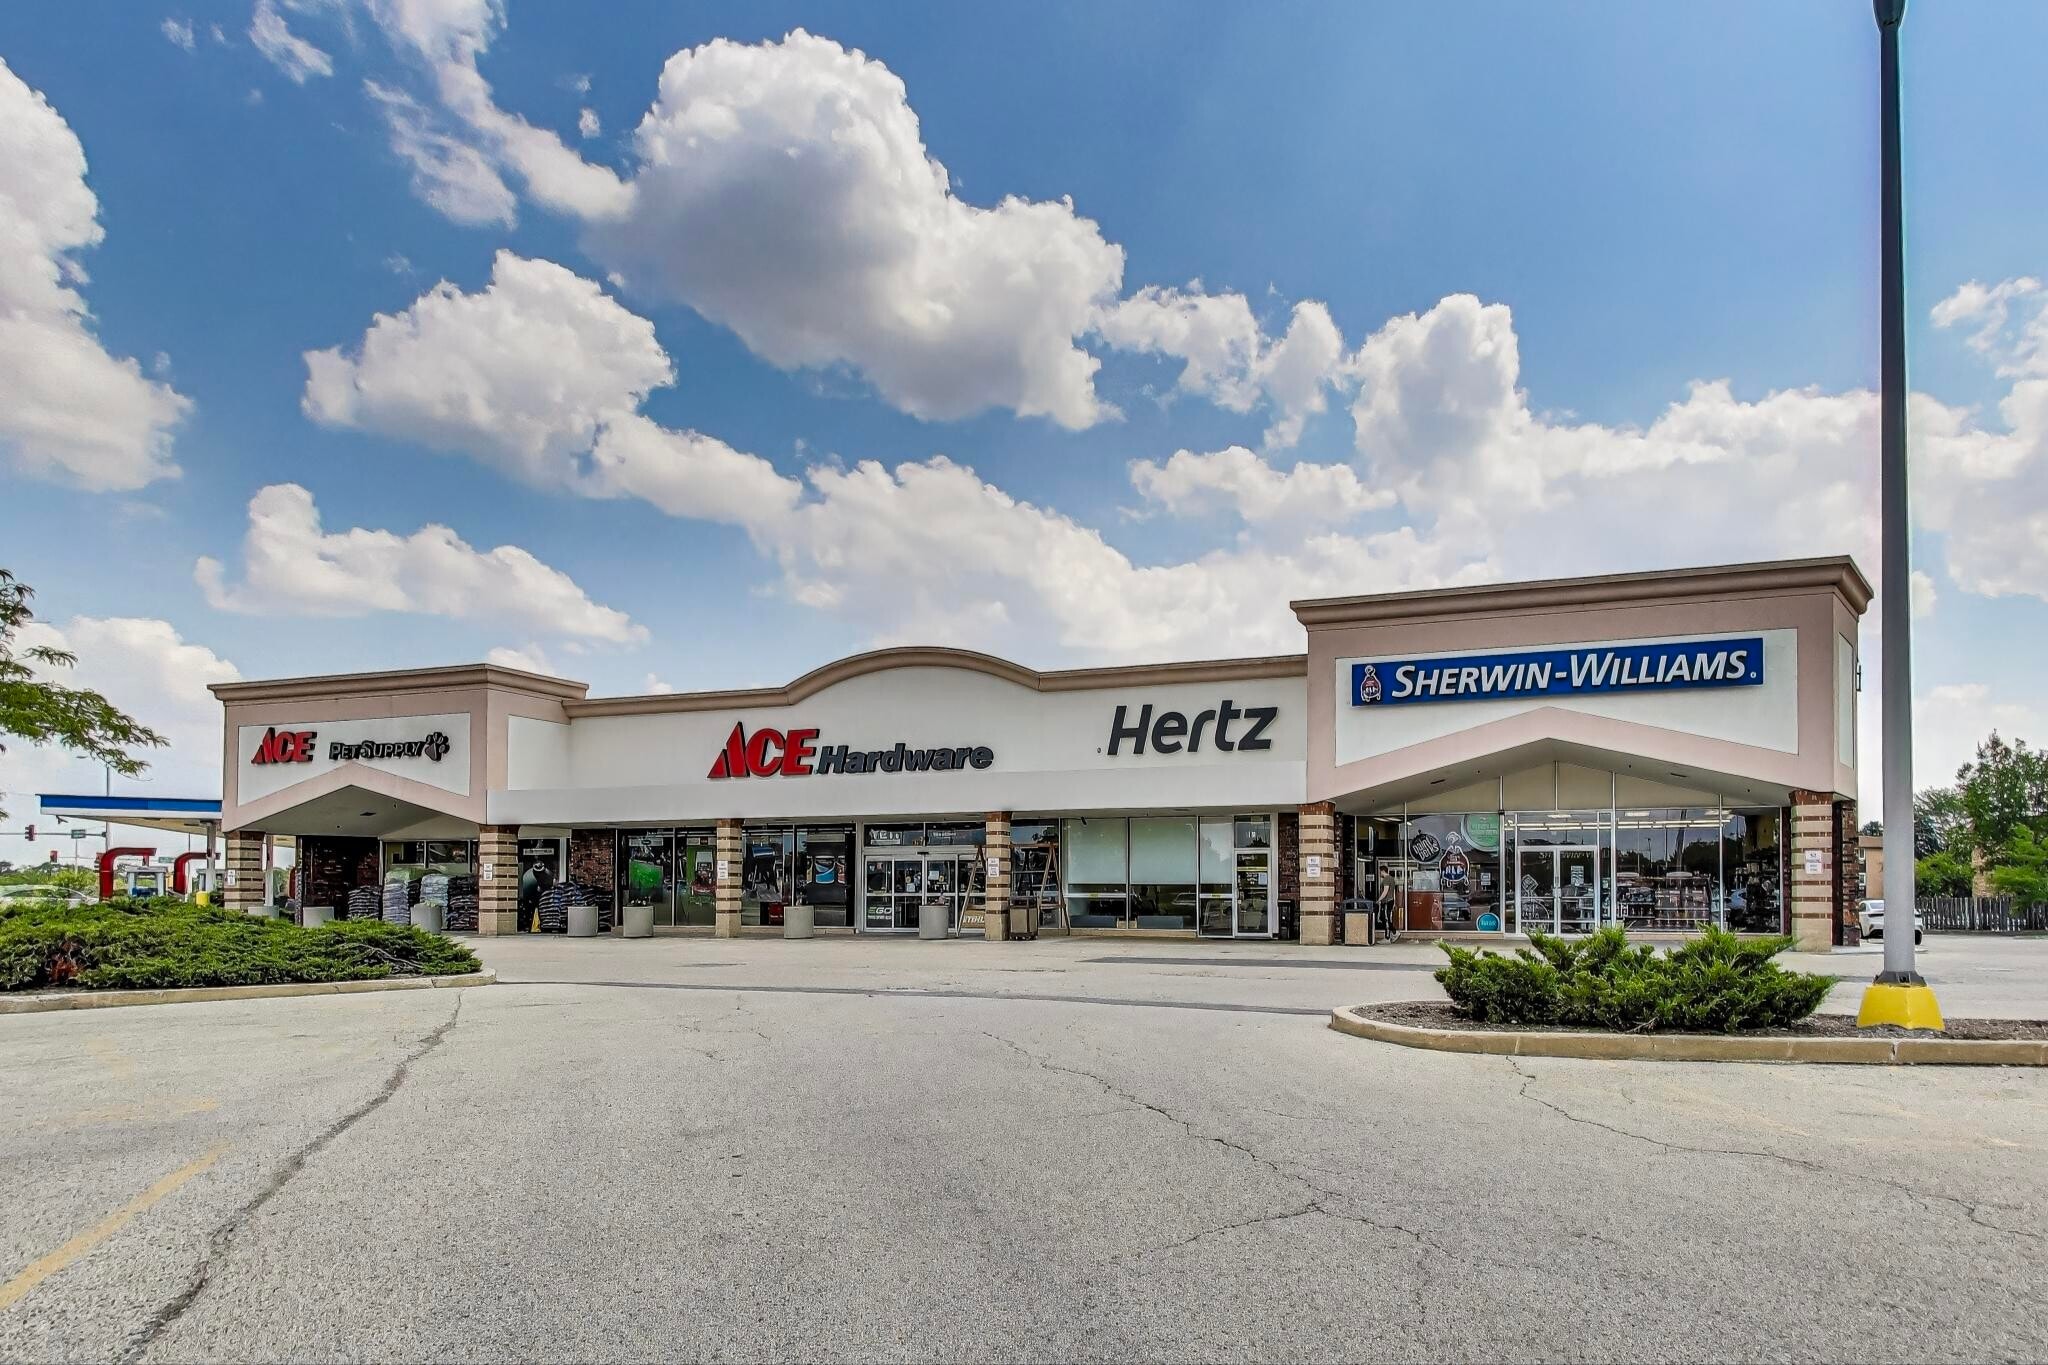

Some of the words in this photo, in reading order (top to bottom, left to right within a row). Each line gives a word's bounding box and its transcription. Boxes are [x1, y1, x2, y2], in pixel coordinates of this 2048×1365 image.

[251, 727, 317, 764] ACE
[329, 741, 361, 760] PET
[361, 740, 425, 759] SUPPLY
[707, 721, 820, 779] ACE
[818, 743, 994, 774] Hardware
[1107, 699, 1278, 756] Hertz
[868, 906, 892, 914] EGO
